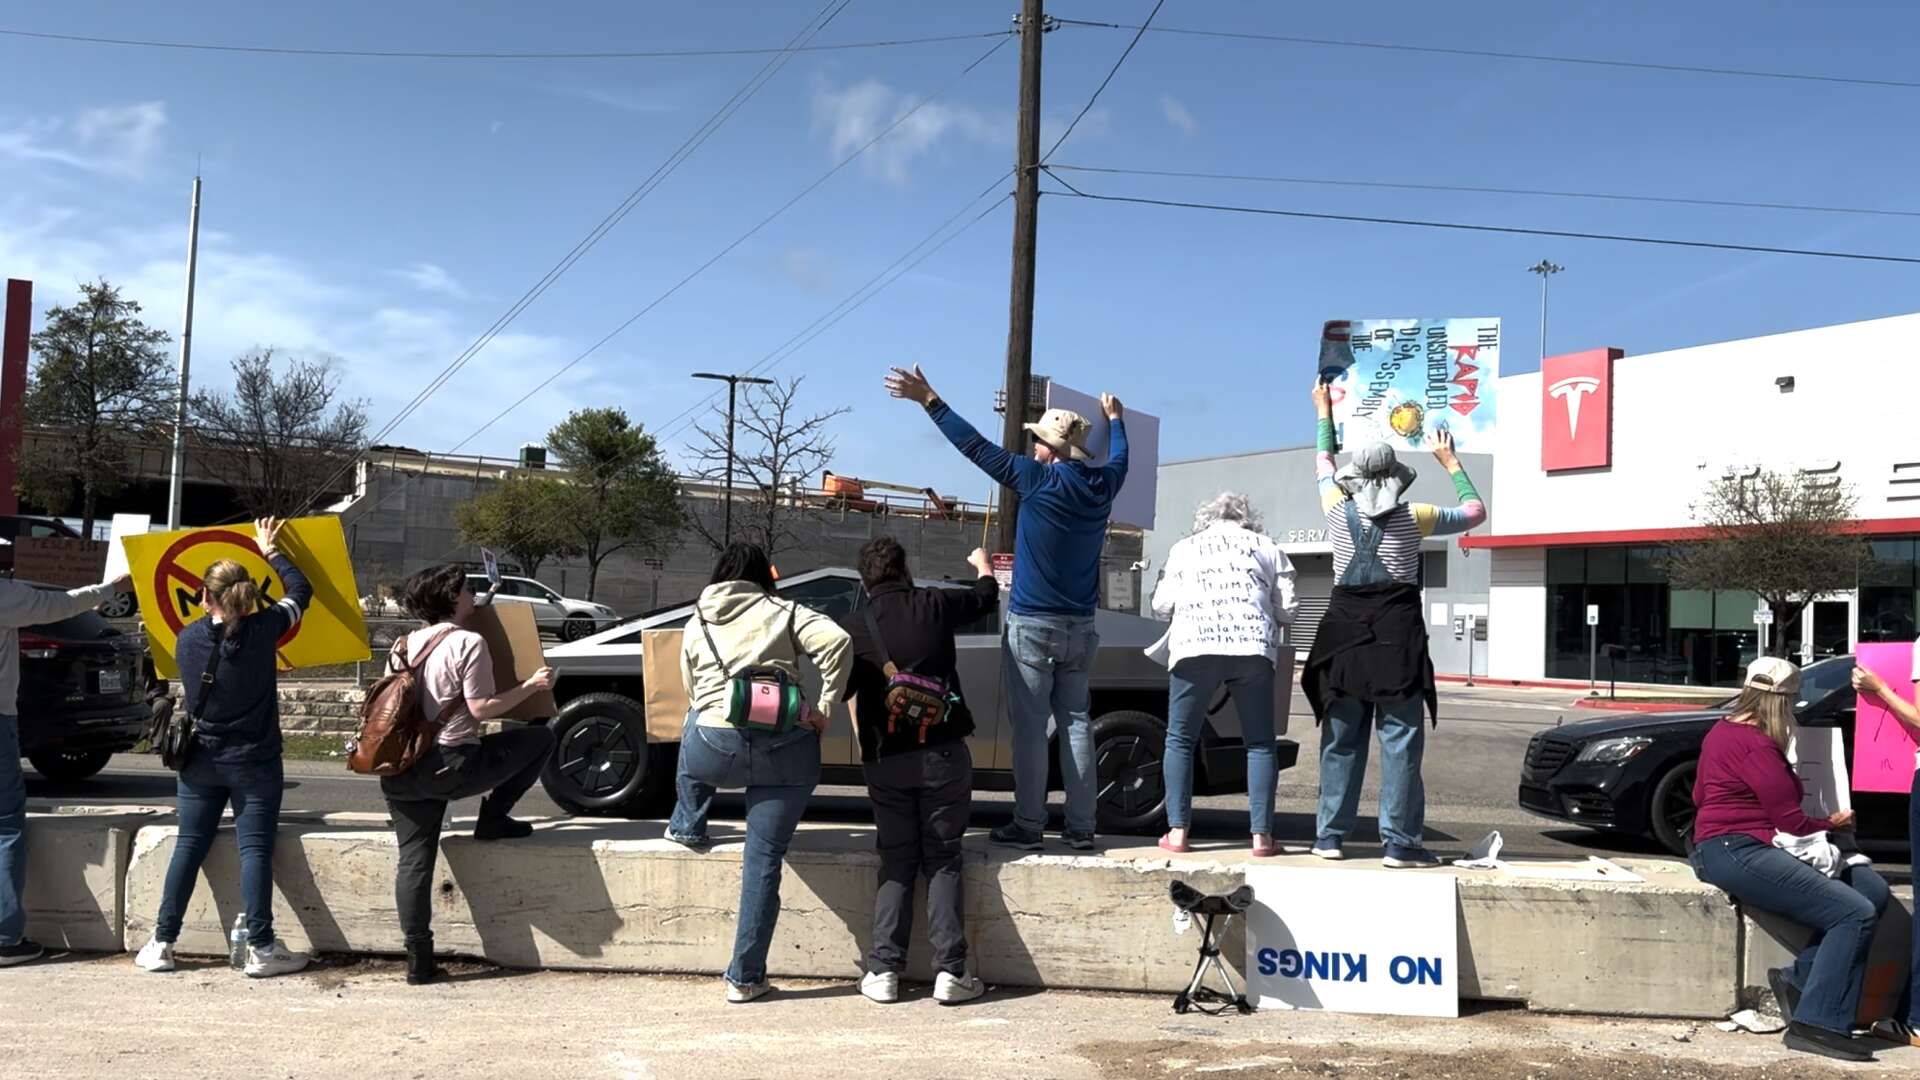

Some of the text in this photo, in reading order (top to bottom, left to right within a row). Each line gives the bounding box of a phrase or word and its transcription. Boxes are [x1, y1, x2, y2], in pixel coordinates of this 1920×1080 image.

[1352, 331, 1373, 354] THE
[1374, 328, 1395, 345] OF
[1477, 324, 1498, 350] THE
[1352, 327, 1421, 420] DISASSEMBLY
[1425, 326, 1448, 410] UNSCHEDULED
[176, 575, 279, 618] MK
[1257, 947, 1443, 986] NO KINGS
